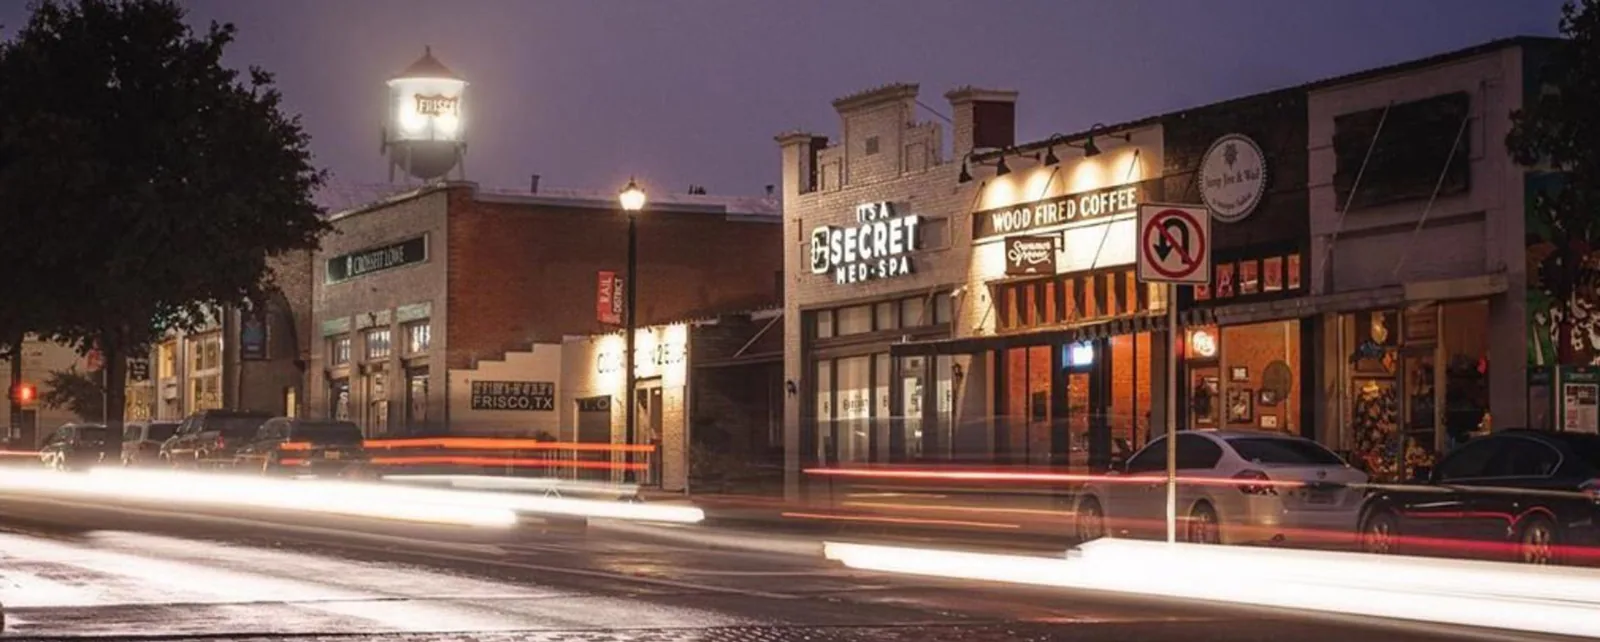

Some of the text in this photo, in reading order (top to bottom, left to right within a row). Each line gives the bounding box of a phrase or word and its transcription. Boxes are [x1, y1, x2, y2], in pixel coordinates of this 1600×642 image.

[879, 201, 889, 219] A
[992, 188, 1137, 233] WOOD FIRED COFFEE
[830, 215, 918, 265] SECRET
[600, 278, 611, 303] RAIL
[613, 278, 623, 313] DISTRICT
